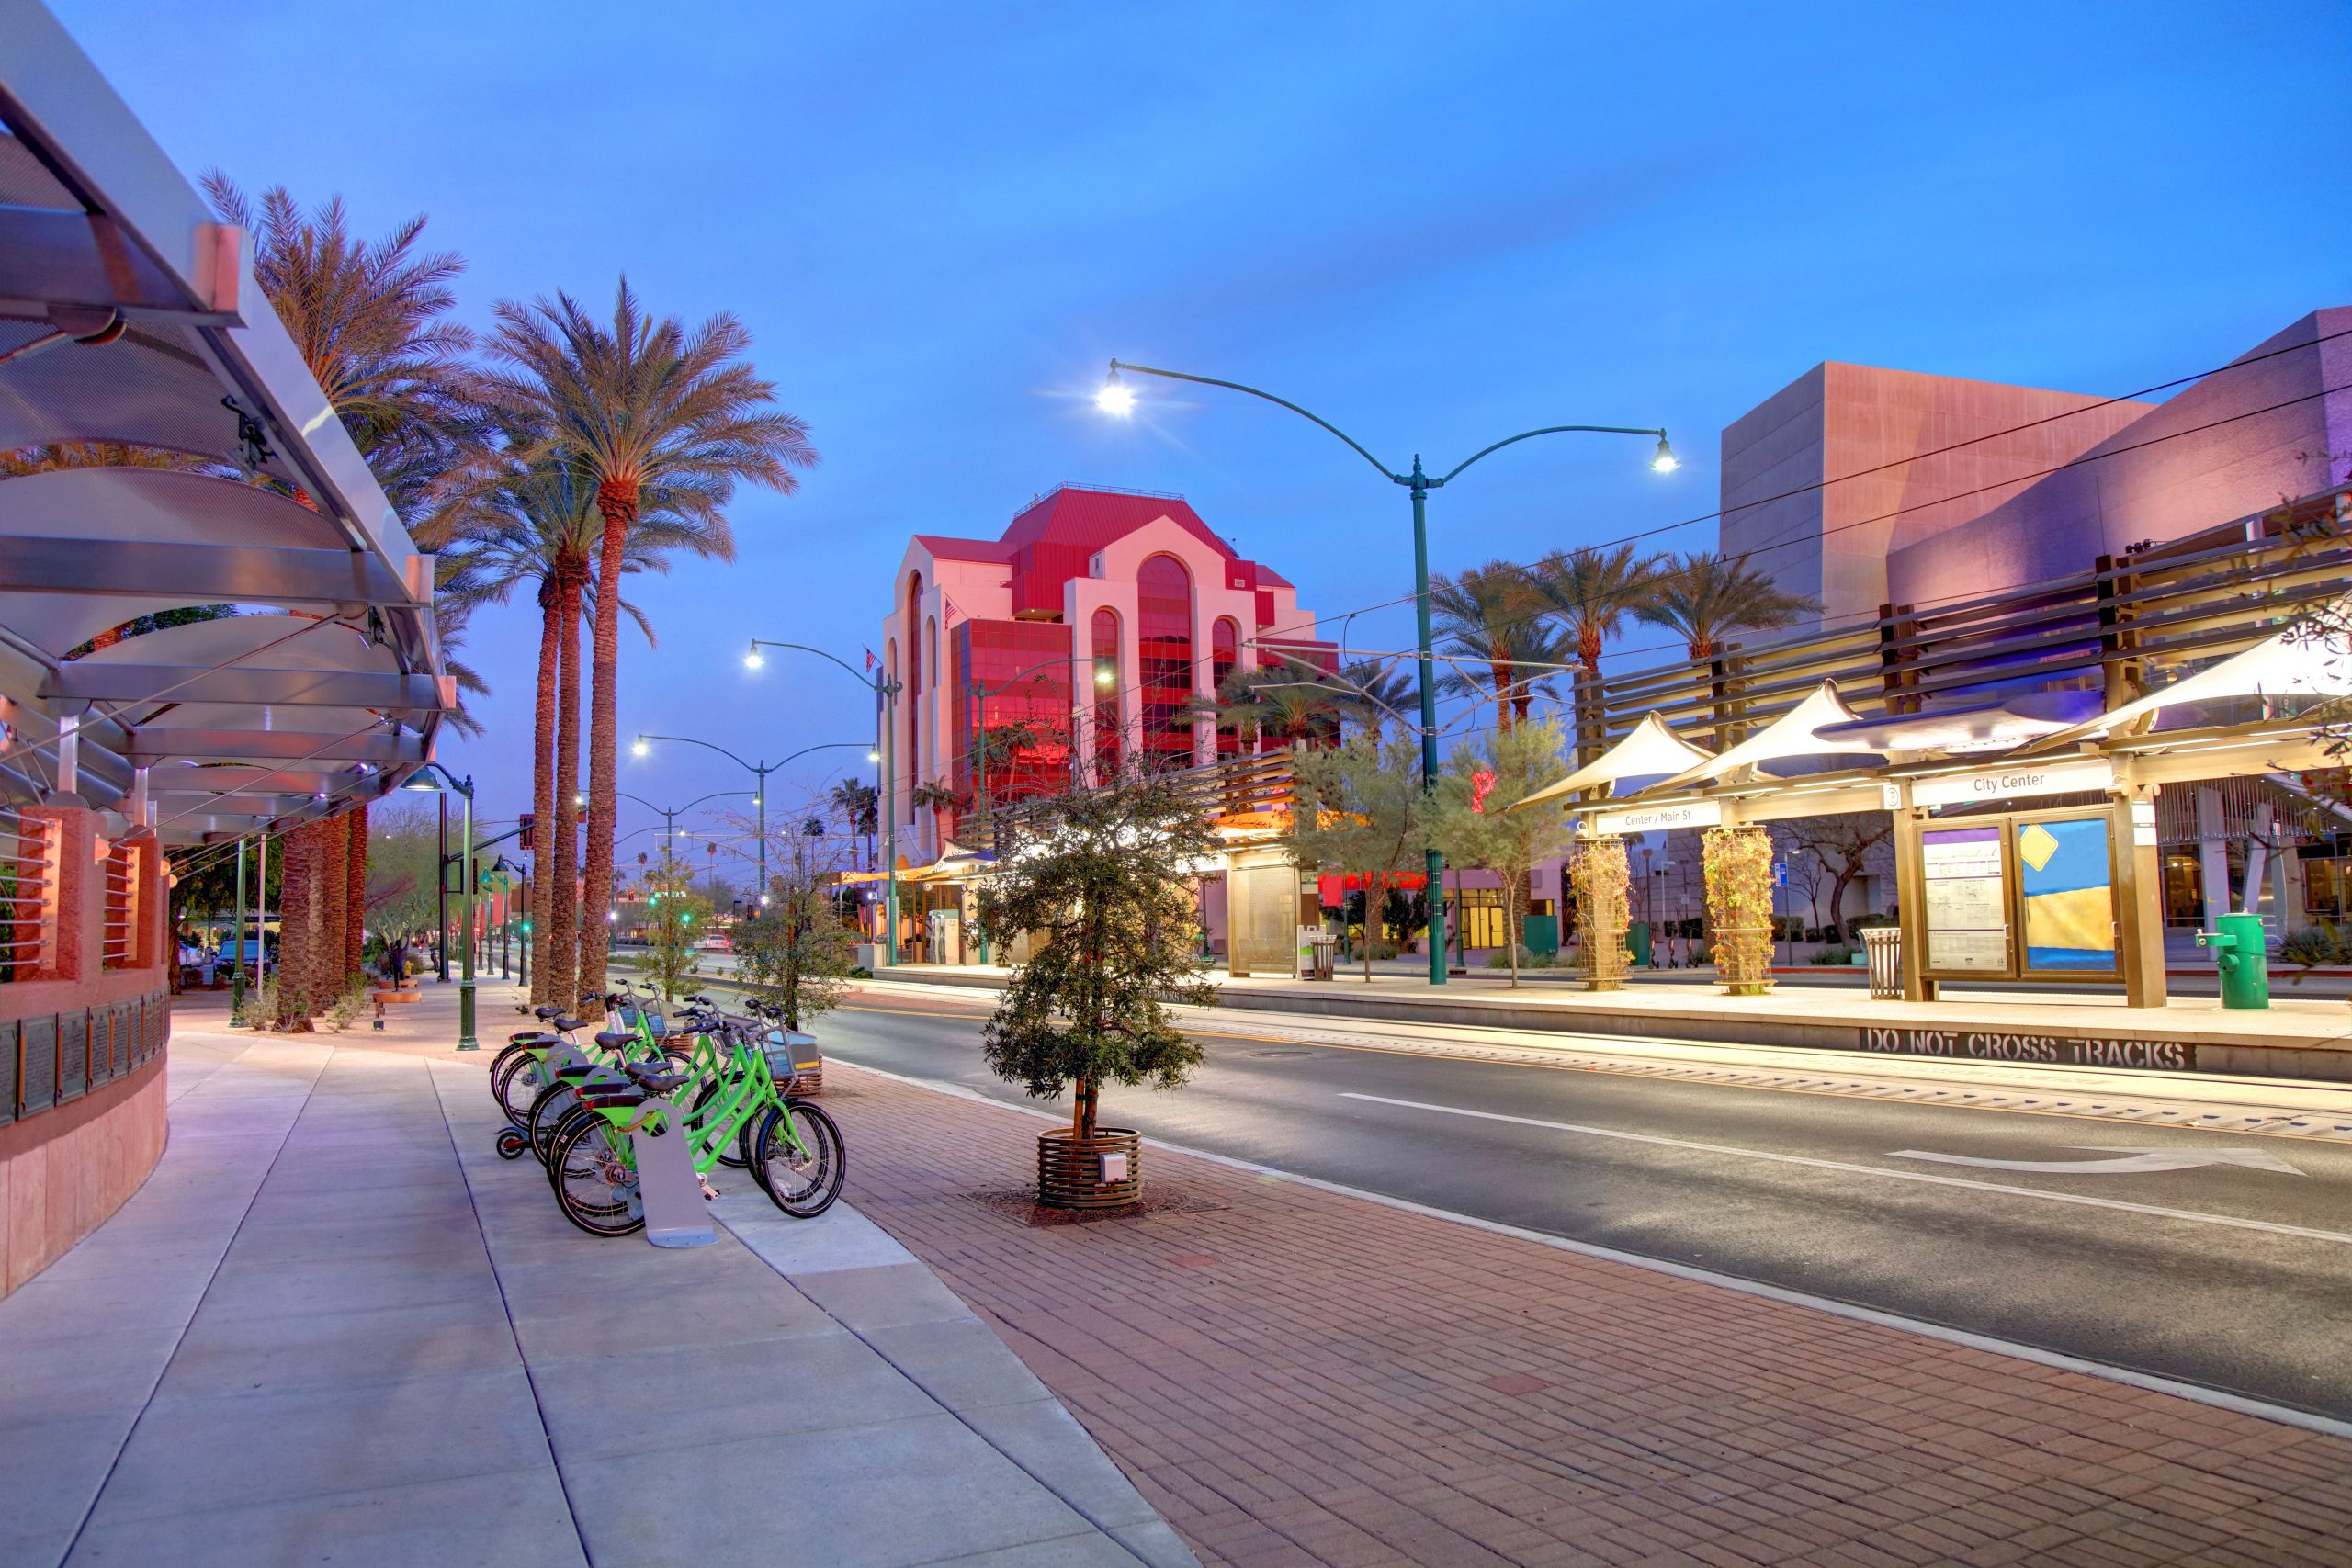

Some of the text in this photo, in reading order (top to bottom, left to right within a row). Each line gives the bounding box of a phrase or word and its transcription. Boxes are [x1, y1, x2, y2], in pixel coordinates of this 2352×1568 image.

[1974, 773, 2045, 793] City Center
[1625, 815, 1652, 826] Center
[1661, 812, 1680, 822] Main
[1683, 810, 1694, 820] St.
[1867, 1028, 2184, 1071] DO NOT CROSS TRACKS
